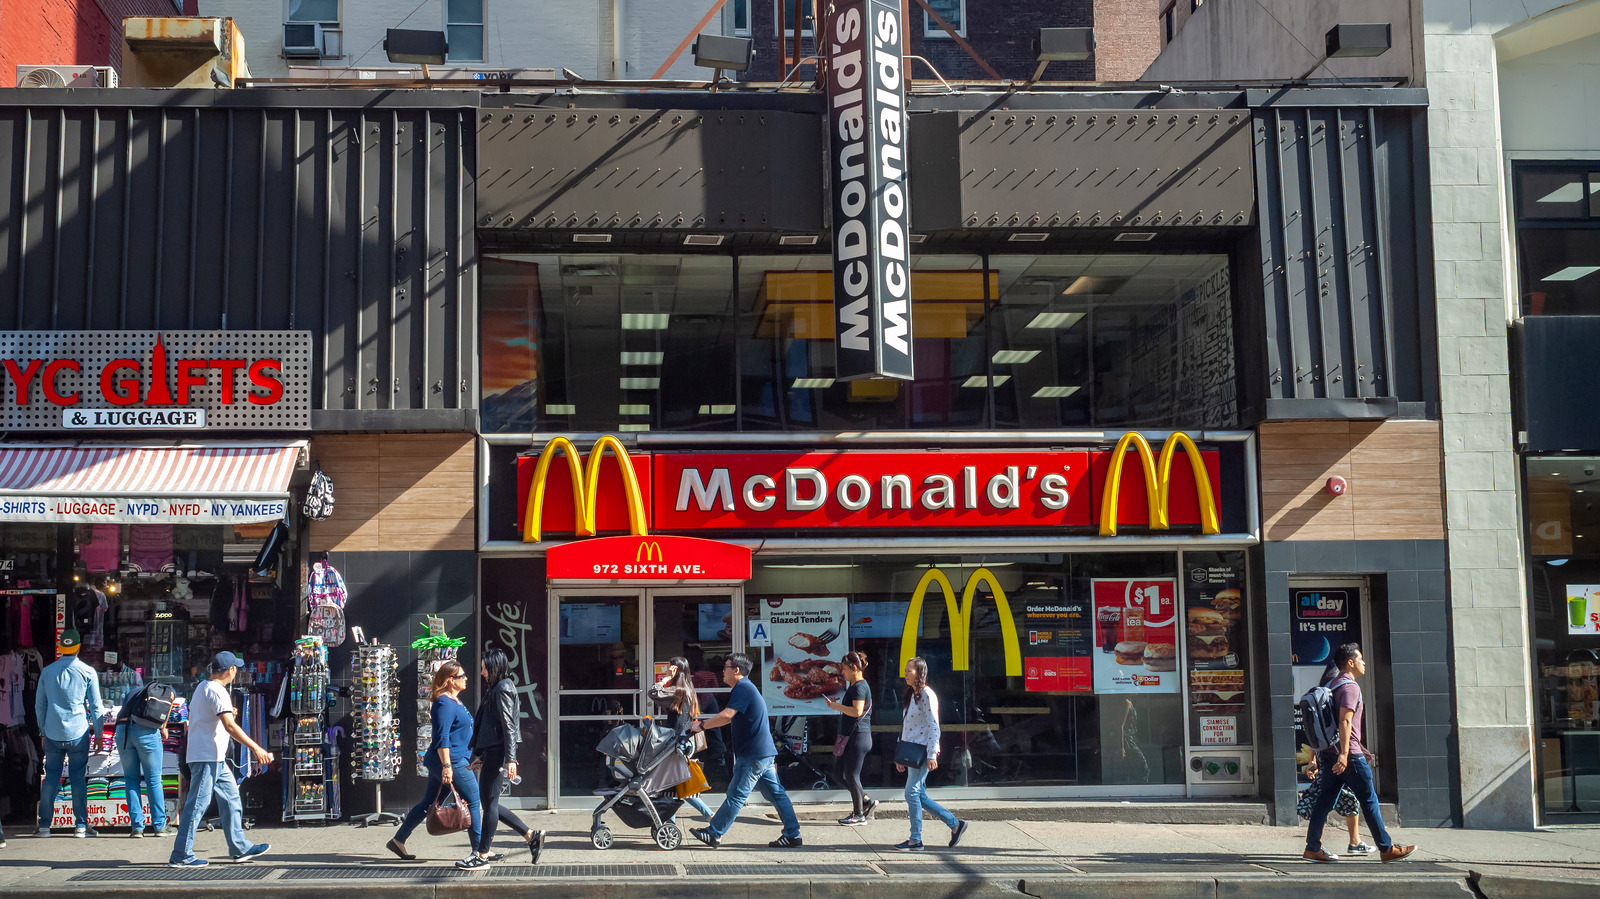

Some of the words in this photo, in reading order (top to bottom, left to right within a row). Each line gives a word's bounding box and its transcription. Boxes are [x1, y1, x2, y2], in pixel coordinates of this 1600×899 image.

[832, 6, 870, 351] McDonald's
[874, 9, 909, 356] McDonald's
[71, 411, 88, 425] &
[94, 411, 198, 425] LUGGAGE
[675, 465, 1070, 512] McDonald's
[56, 502, 116, 515] LUGGAGE
[127, 503, 159, 516] NYPD
[169, 503, 200, 516] NYFD
[211, 503, 228, 516] NY
[230, 503, 283, 516] YANKEES
[593, 564, 619, 574] 972
[624, 564, 668, 574] SIXTH
[672, 564, 706, 574] AVE.
[1134, 585, 1160, 615] $1
[1301, 593, 1320, 606] all
[1316, 596, 1344, 611] day
[770, 616, 799, 624] Glazed
[800, 616, 833, 624] Tenders
[1127, 617, 1141, 626] tea
[1299, 622, 1317, 632] It's
[1318, 622, 1347, 631] Here!
[753, 623, 768, 639] A
[54, 817, 73, 825] FOR
